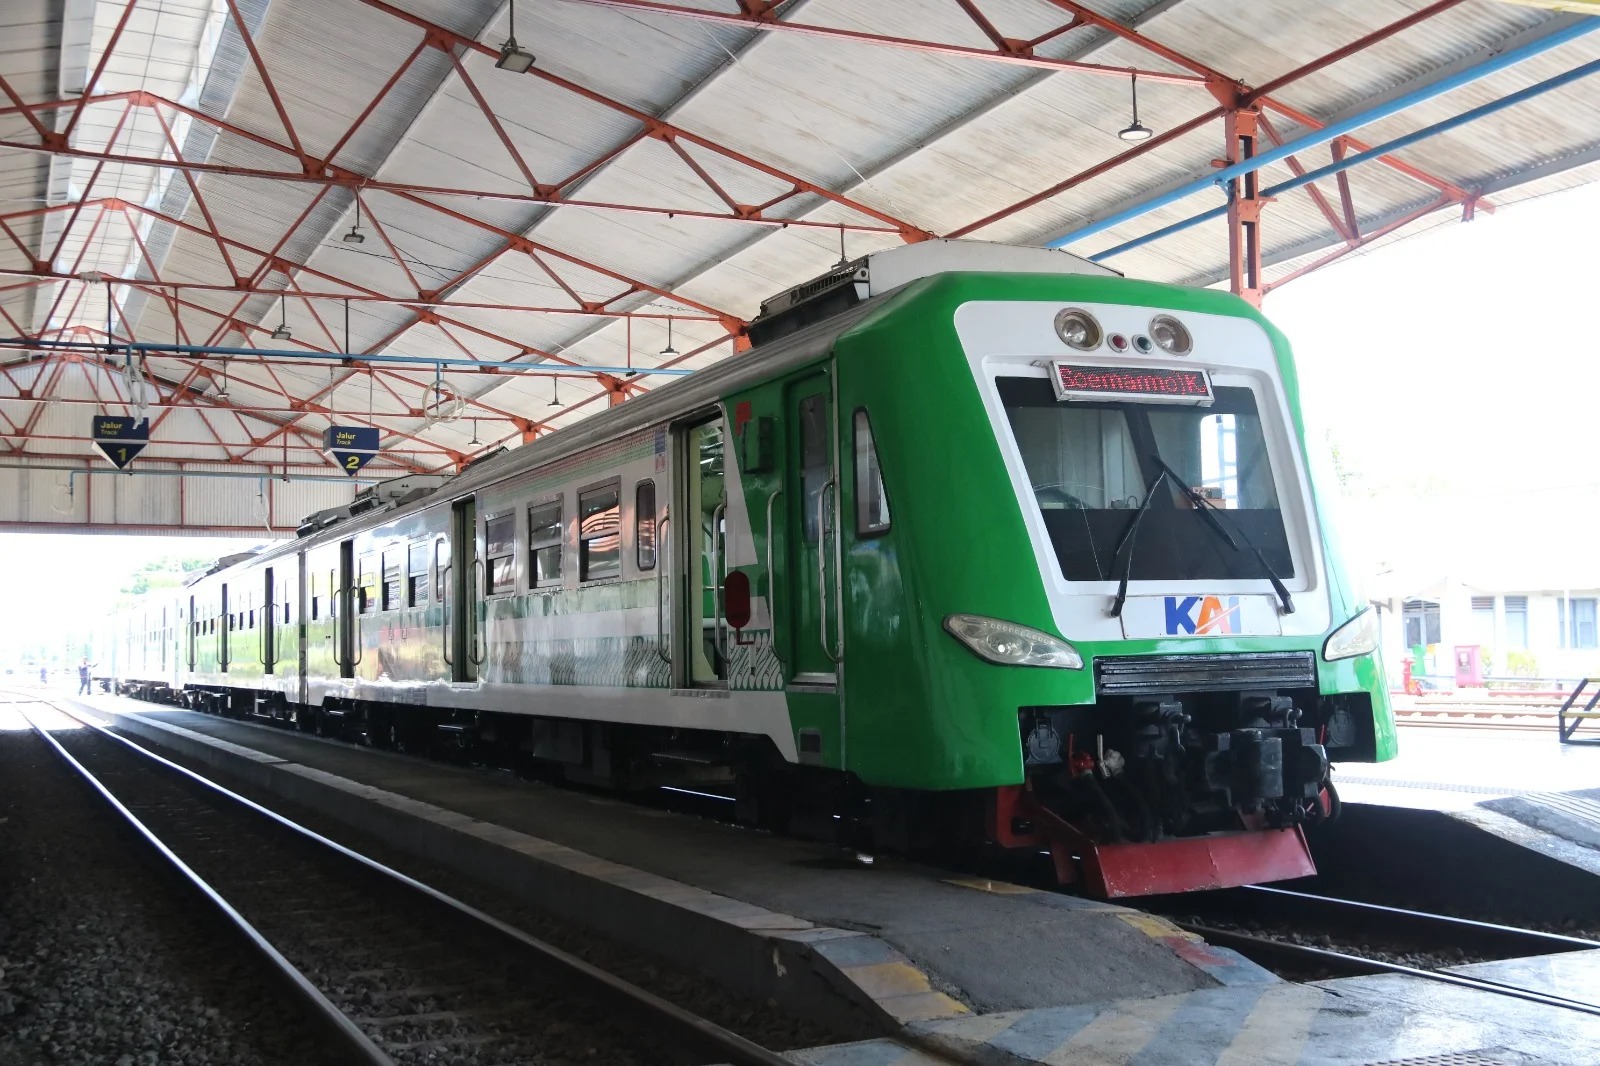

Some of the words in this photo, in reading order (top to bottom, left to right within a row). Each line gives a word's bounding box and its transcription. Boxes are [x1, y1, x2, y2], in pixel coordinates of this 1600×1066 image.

[100, 421, 123, 429] Jalur
[336, 431, 356, 440] Jalur
[117, 447, 127, 462] 1
[345, 455, 360, 469] 2
[1164, 595, 1242, 635] KAI
